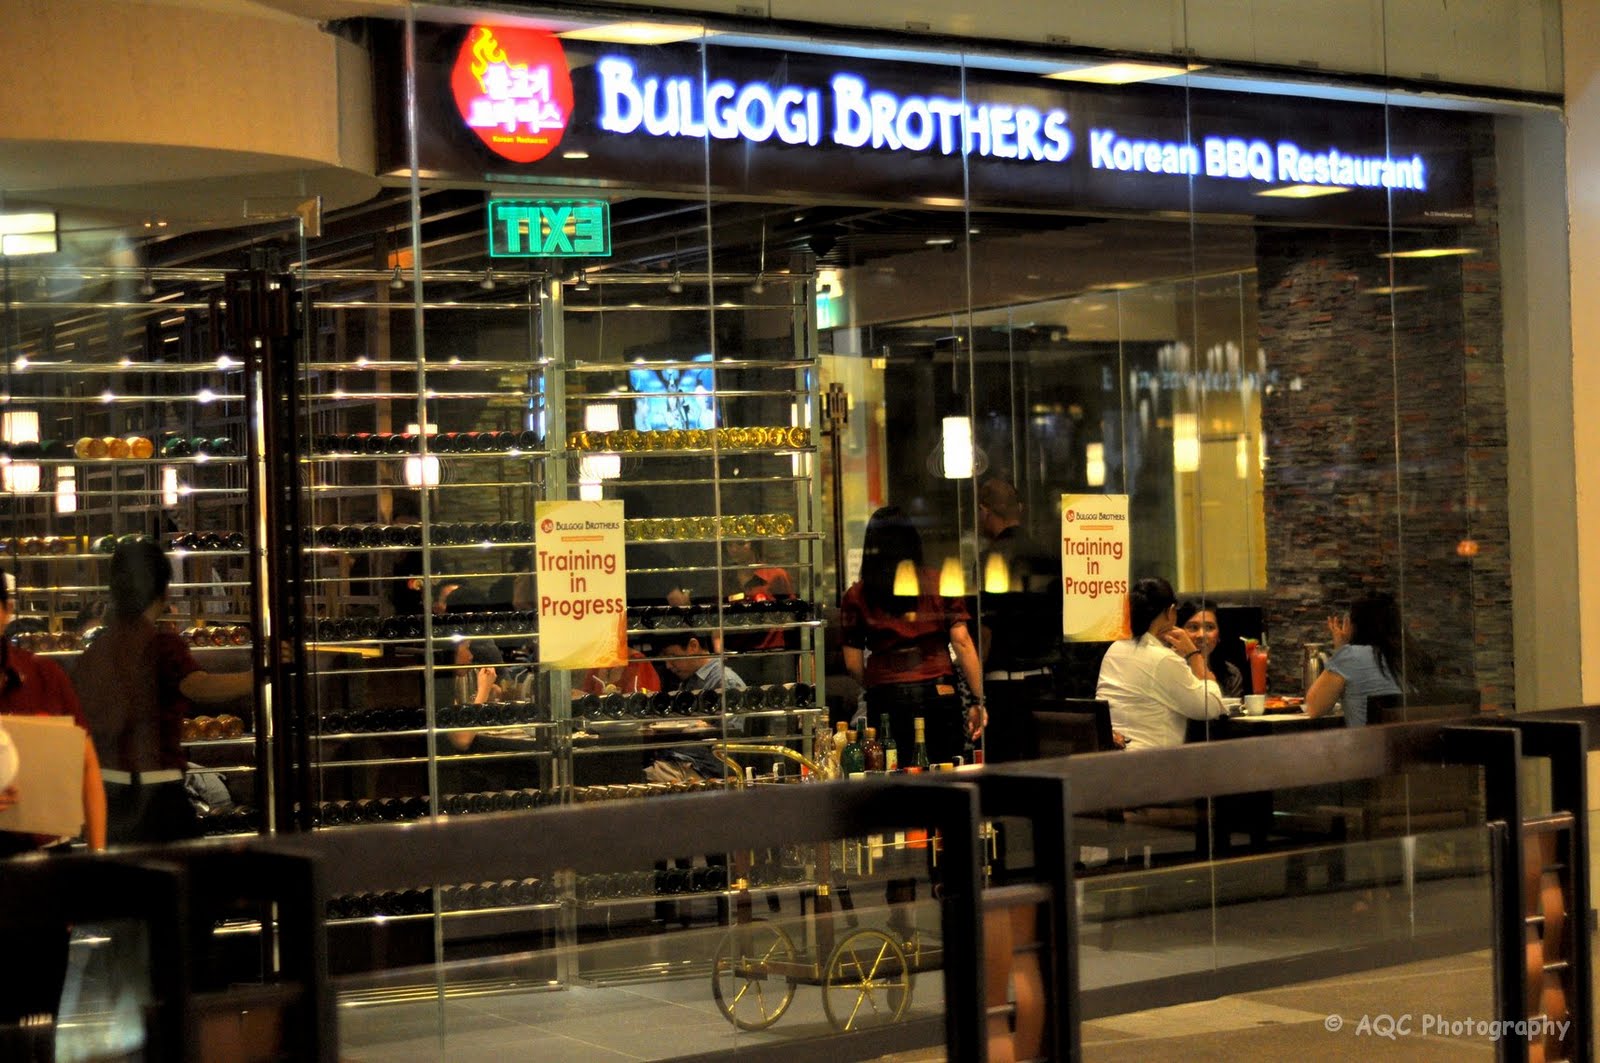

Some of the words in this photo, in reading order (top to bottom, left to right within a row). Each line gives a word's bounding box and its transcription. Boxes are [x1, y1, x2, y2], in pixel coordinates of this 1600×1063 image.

[600, 57, 820, 146] BULGOGI
[832, 75, 1072, 163] BROTHERS
[1089, 130, 1199, 175] Korean
[1204, 137, 1275, 182] BBQ
[1276, 144, 1425, 190] Restaurant
[556, 521, 584, 531] BULGOGI
[585, 521, 620, 530] BROTHERS
[1064, 537, 1123, 560] Training
[539, 550, 616, 575] Training
[1087, 557, 1100, 575] in
[570, 573, 587, 593] in
[1065, 577, 1127, 599] Progress
[541, 596, 624, 620] Progress
